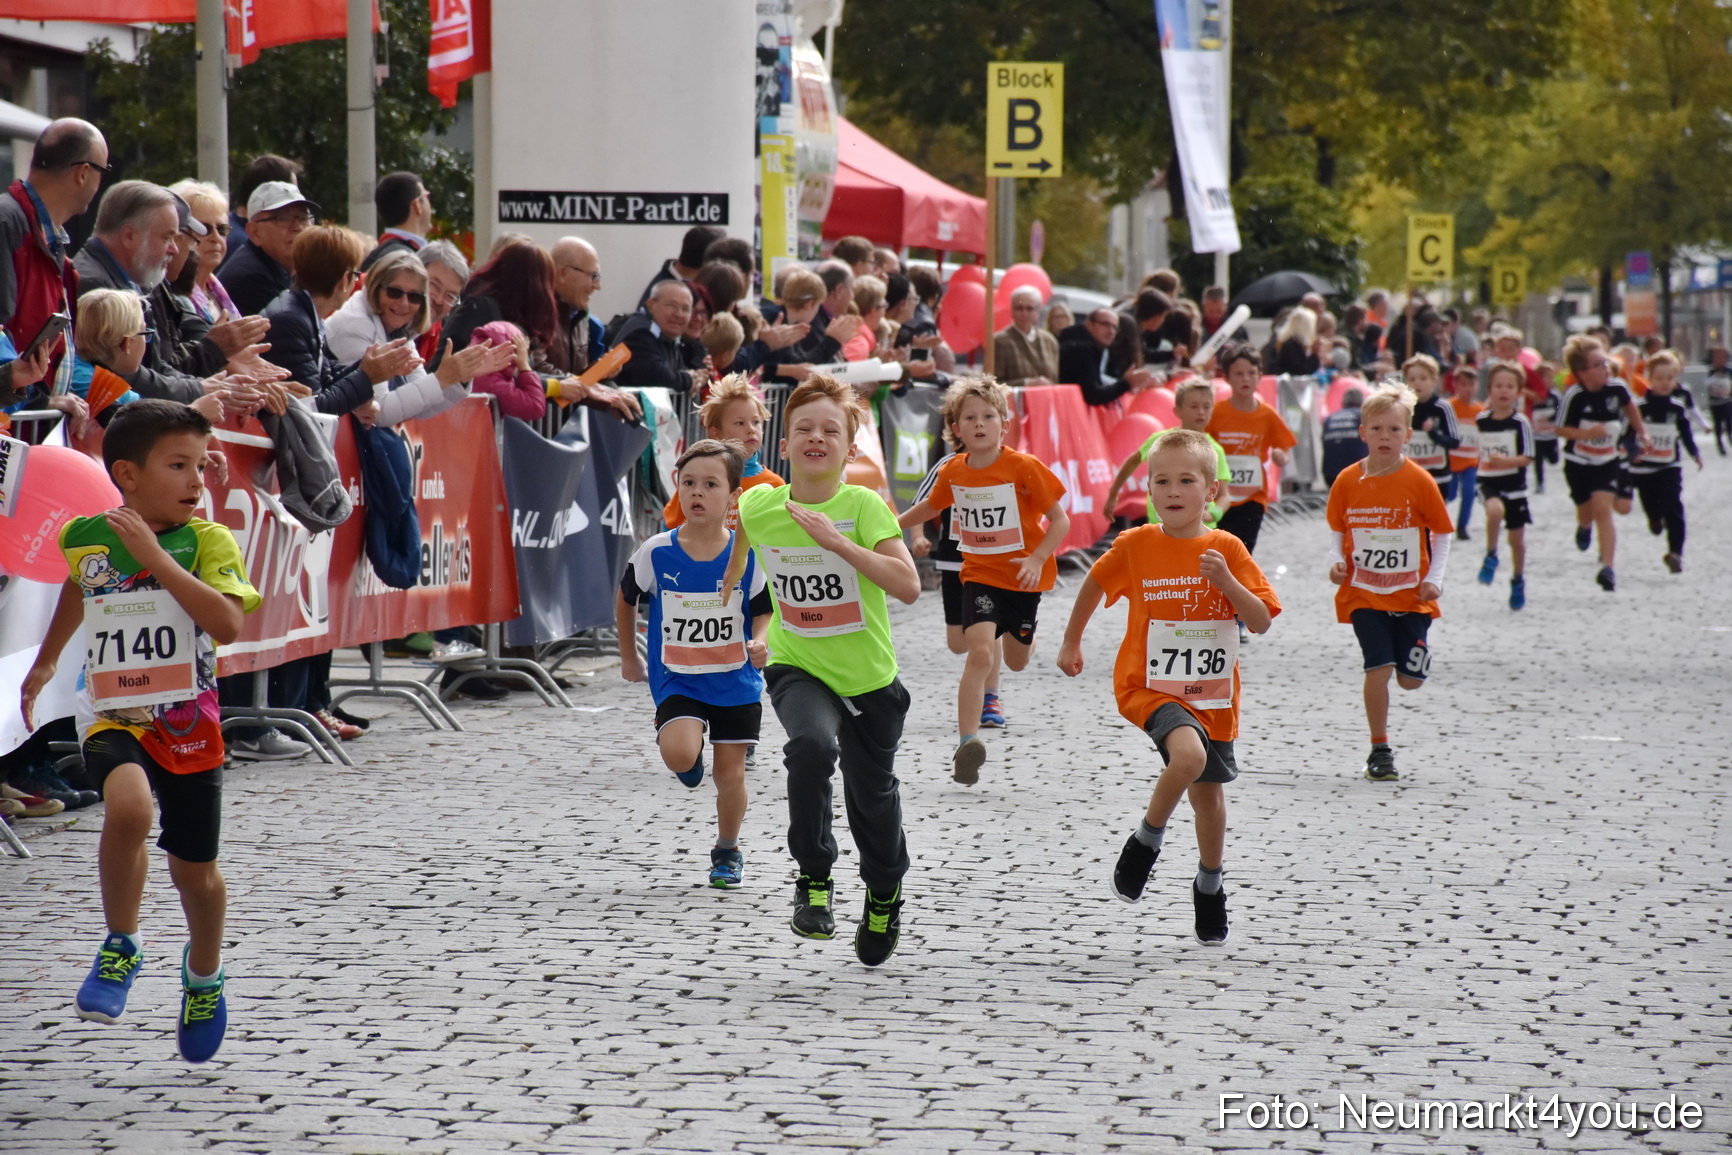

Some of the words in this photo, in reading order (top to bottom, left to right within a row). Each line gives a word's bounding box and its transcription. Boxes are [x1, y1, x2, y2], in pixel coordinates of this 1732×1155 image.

[997, 68, 1054, 88] Block
[1008, 98, 1043, 151] B
[500, 196, 721, 222] www.MINI-Partl.de
[1420, 235, 1440, 266] C
[1501, 271, 1519, 294] D
[1230, 470, 1254, 484] 237
[962, 506, 1007, 528] 7157
[1347, 506, 1391, 515] Neumarkter
[1348, 516, 1382, 524] Stadtlauf
[790, 555, 823, 563] BOCK
[1362, 549, 1408, 569] 7261
[776, 573, 844, 602] 7038
[1142, 576, 1203, 588] Neumarkter
[1143, 588, 1191, 602] Stadtlauf
[114, 602, 156, 615] BOCK
[801, 612, 823, 621] Nico
[672, 616, 733, 642] 7205
[1185, 629, 1217, 638] BOCK
[96, 626, 176, 665] 7140
[1162, 648, 1226, 675] 7136
[118, 674, 150, 688] Noah
[1184, 685, 1203, 695] Elias
